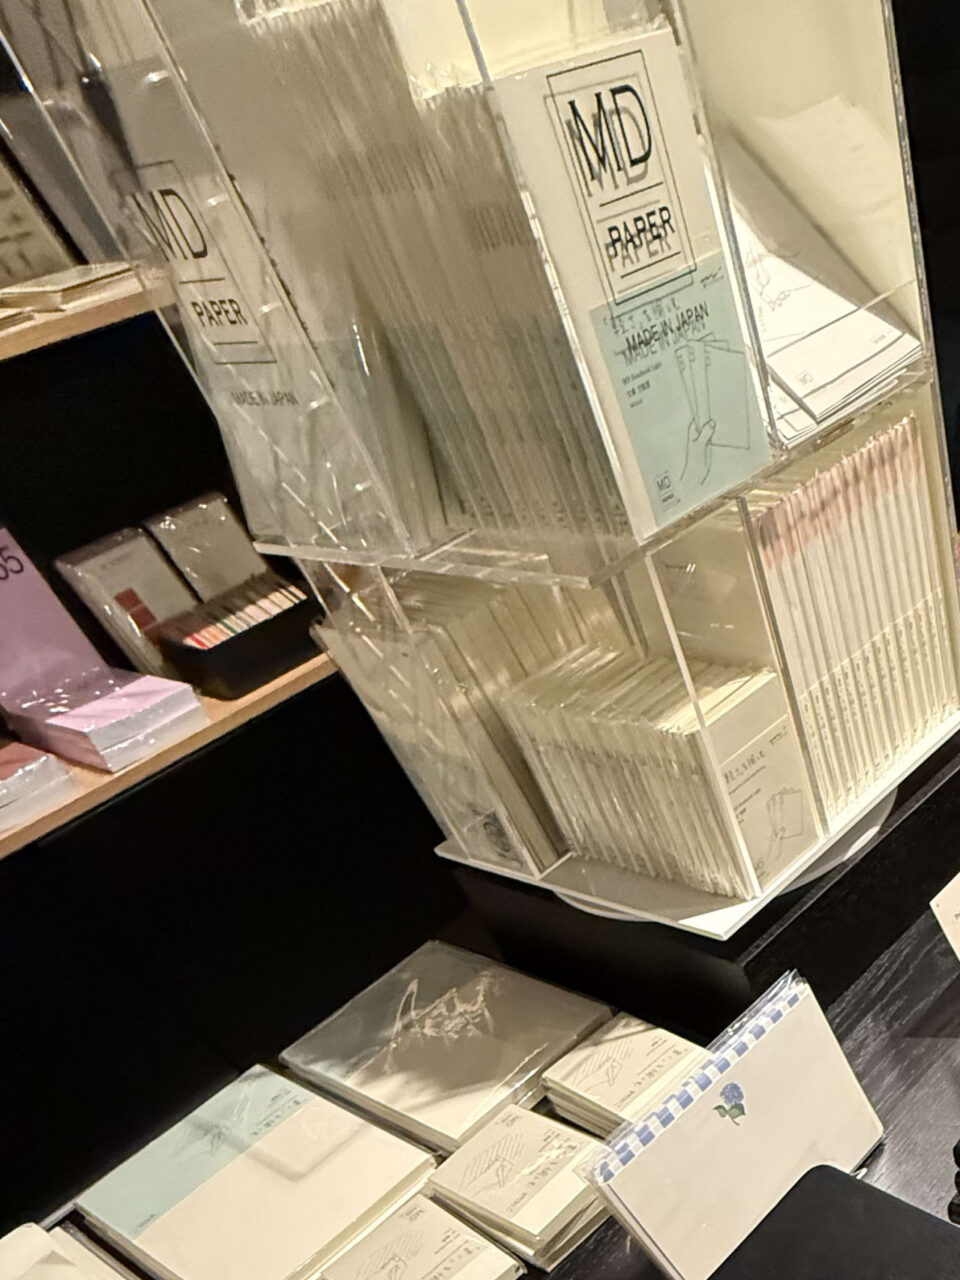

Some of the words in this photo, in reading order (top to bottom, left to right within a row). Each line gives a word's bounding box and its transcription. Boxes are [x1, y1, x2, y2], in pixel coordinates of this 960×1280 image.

[568, 84, 652, 182] MD
[133, 188, 208, 262] MD
[608, 206, 676, 258] PAPER
[191, 298, 248, 327] PAPER
[625, 327, 660, 352] MADE
[660, 319, 674, 337] IN
[675, 301, 710, 331] JAPAN
